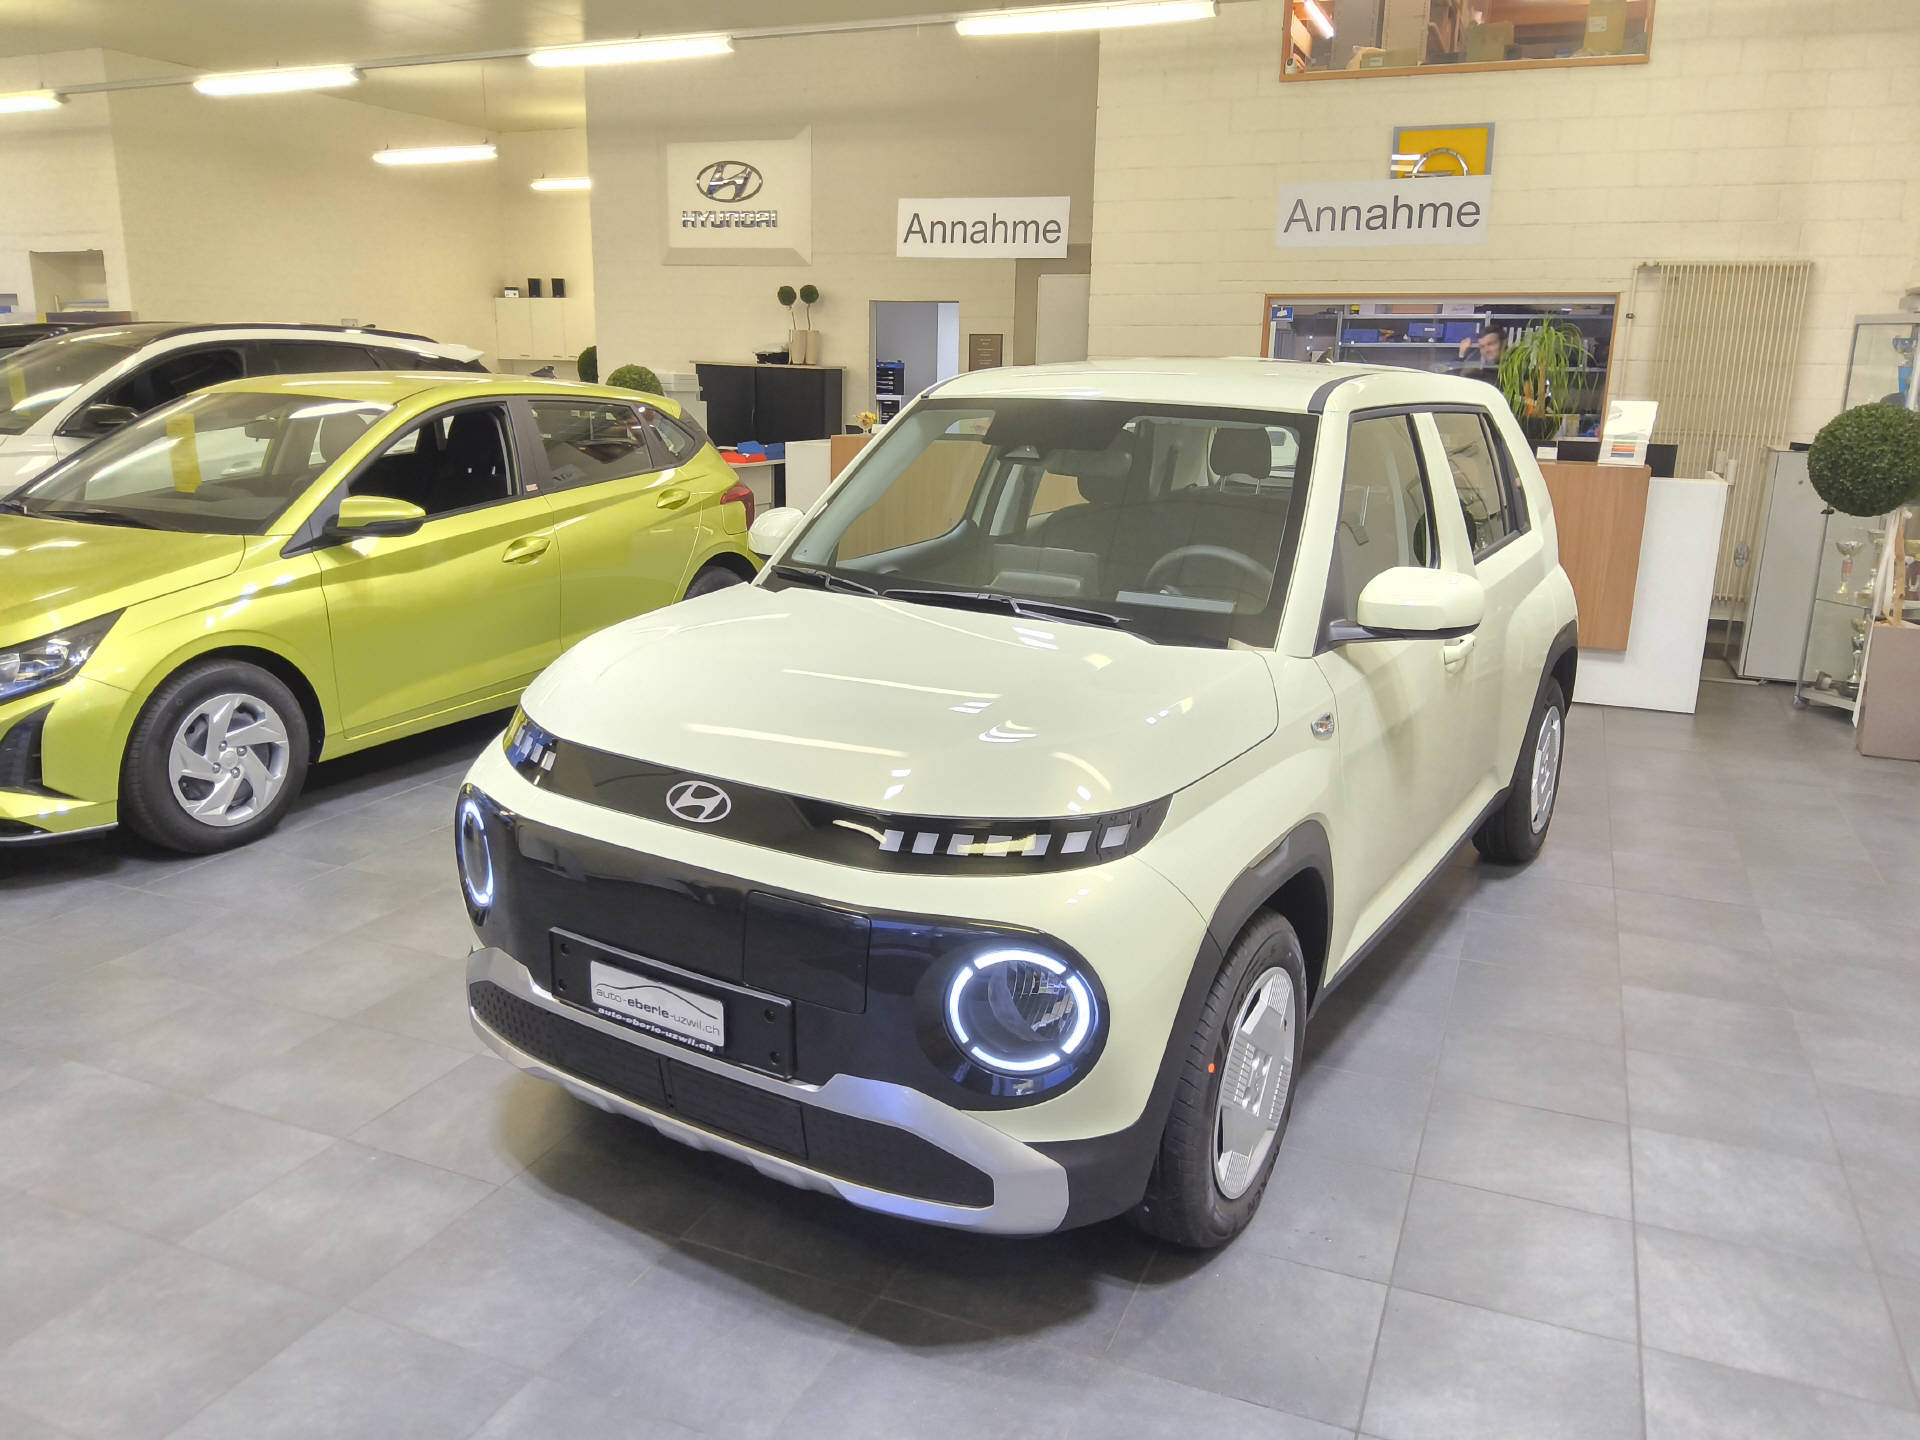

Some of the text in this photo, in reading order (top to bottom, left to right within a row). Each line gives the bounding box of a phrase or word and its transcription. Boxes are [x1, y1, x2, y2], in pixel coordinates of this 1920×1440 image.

[682, 210, 778, 228] HYUNDAI
[903, 212, 1062, 244] Annahme
[1284, 194, 1481, 233] Annahme
[596, 988, 720, 1036] auto-eberle-uzwil.ch
[598, 1007, 714, 1053] auto-eberle-uzwil.ch
